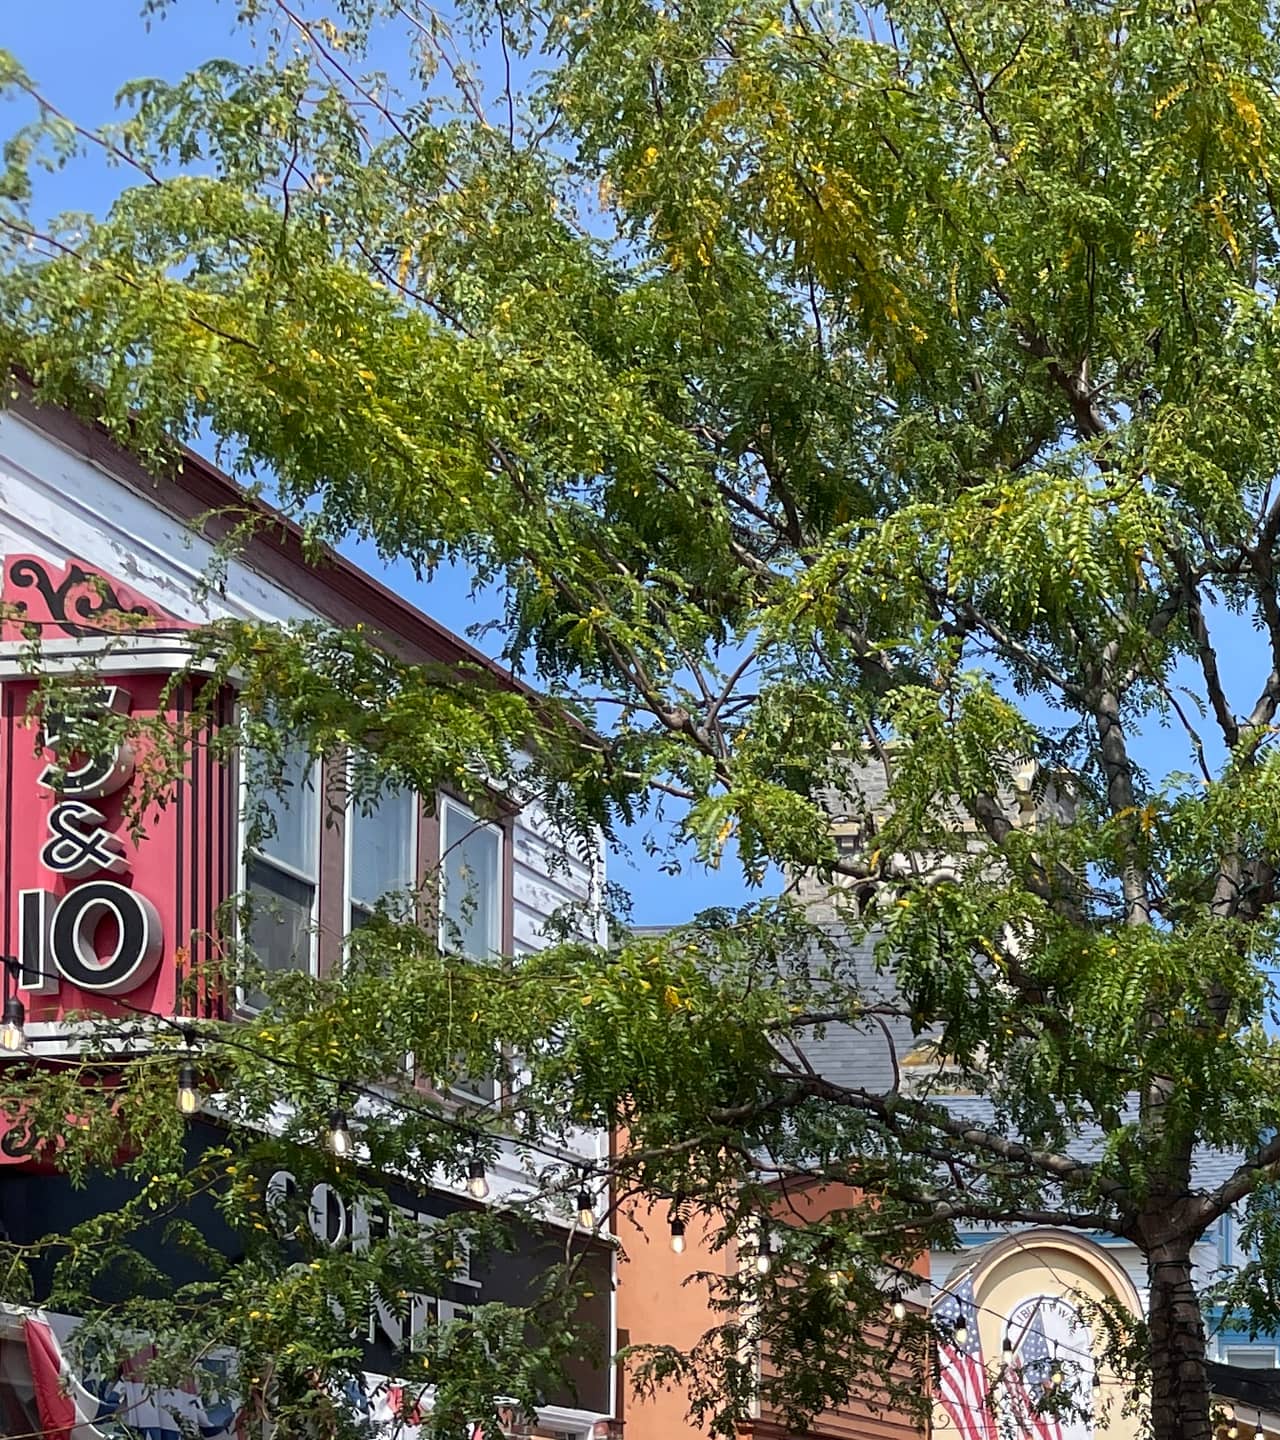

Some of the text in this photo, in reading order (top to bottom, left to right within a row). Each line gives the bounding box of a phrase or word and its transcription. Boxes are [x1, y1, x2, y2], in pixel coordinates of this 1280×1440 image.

[37, 686, 118, 793] 5
[40, 800, 112, 873] &
[19, 880, 148, 989] 10
